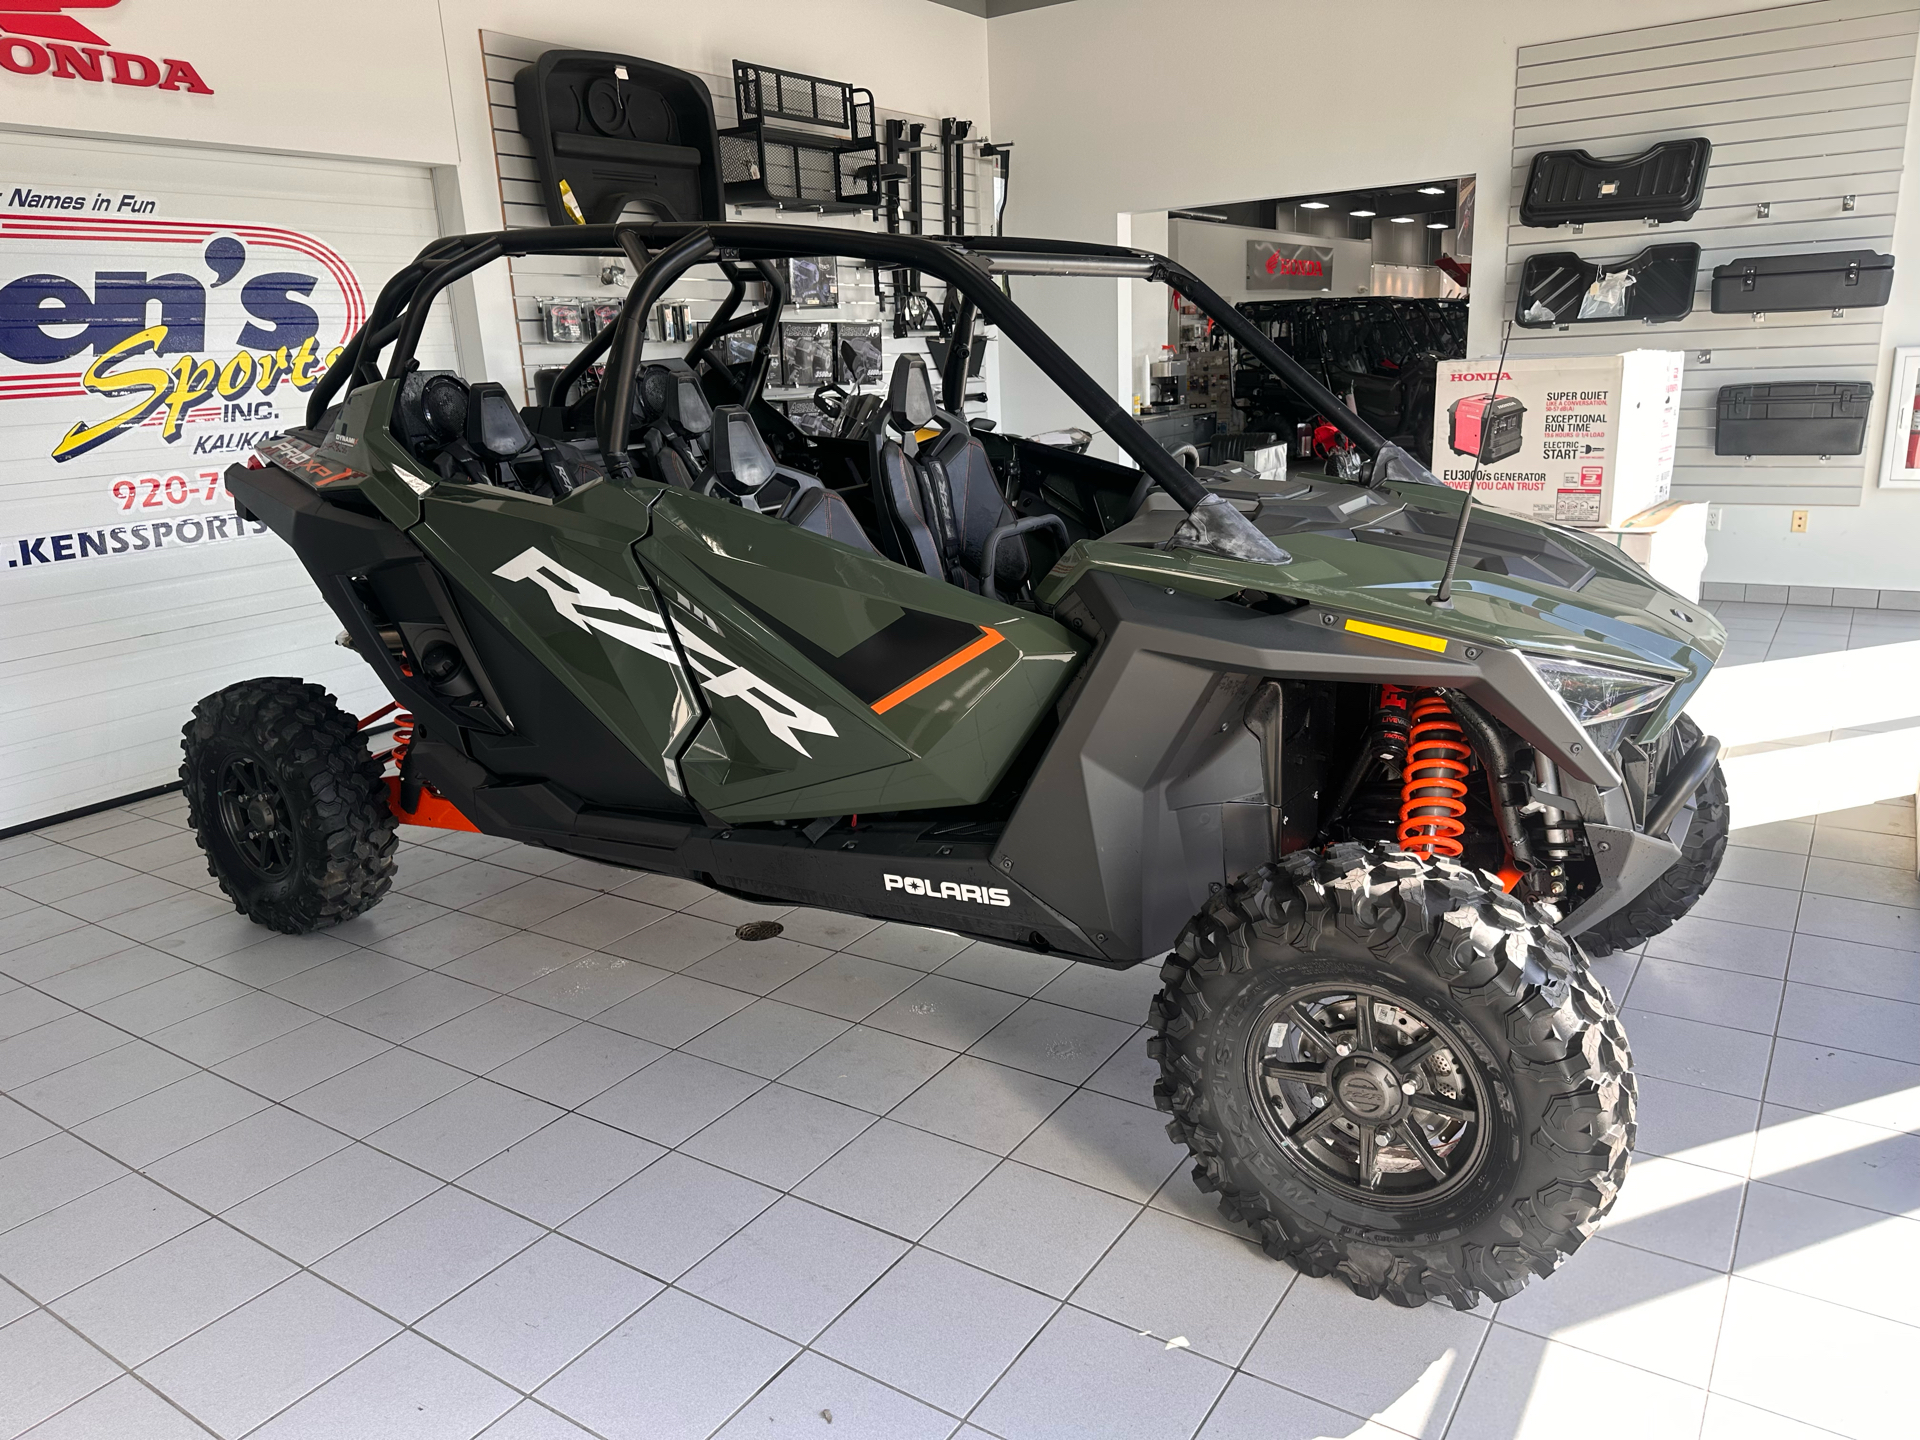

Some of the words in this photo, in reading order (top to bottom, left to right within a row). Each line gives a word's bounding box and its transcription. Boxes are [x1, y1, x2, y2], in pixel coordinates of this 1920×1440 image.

[0, 36, 214, 95] ONDA
[8, 188, 86, 210] Names
[92, 193, 111, 211] in
[117, 194, 155, 213] Fun
[1280, 258, 1323, 276] HONDA
[1450, 372, 1513, 382] HONDA
[1546, 391, 1577, 401] SUPER
[1580, 391, 1608, 400] QUIET
[224, 402, 279, 422] INC.
[1545, 414, 1607, 423] EXCEPTIONAL
[1545, 424, 1565, 432] RUN
[1568, 423, 1591, 432] TIME
[193, 430, 279, 455] KAUKA
[1543, 449, 1578, 459] START
[1494, 472, 1546, 481] GENERATOR
[113, 472, 234, 510] 920-7
[1476, 481, 1494, 490] YOU
[1495, 481, 1514, 490] CAN
[1517, 482, 1545, 491] TRUST
[883, 873, 1011, 907] POLARIS
